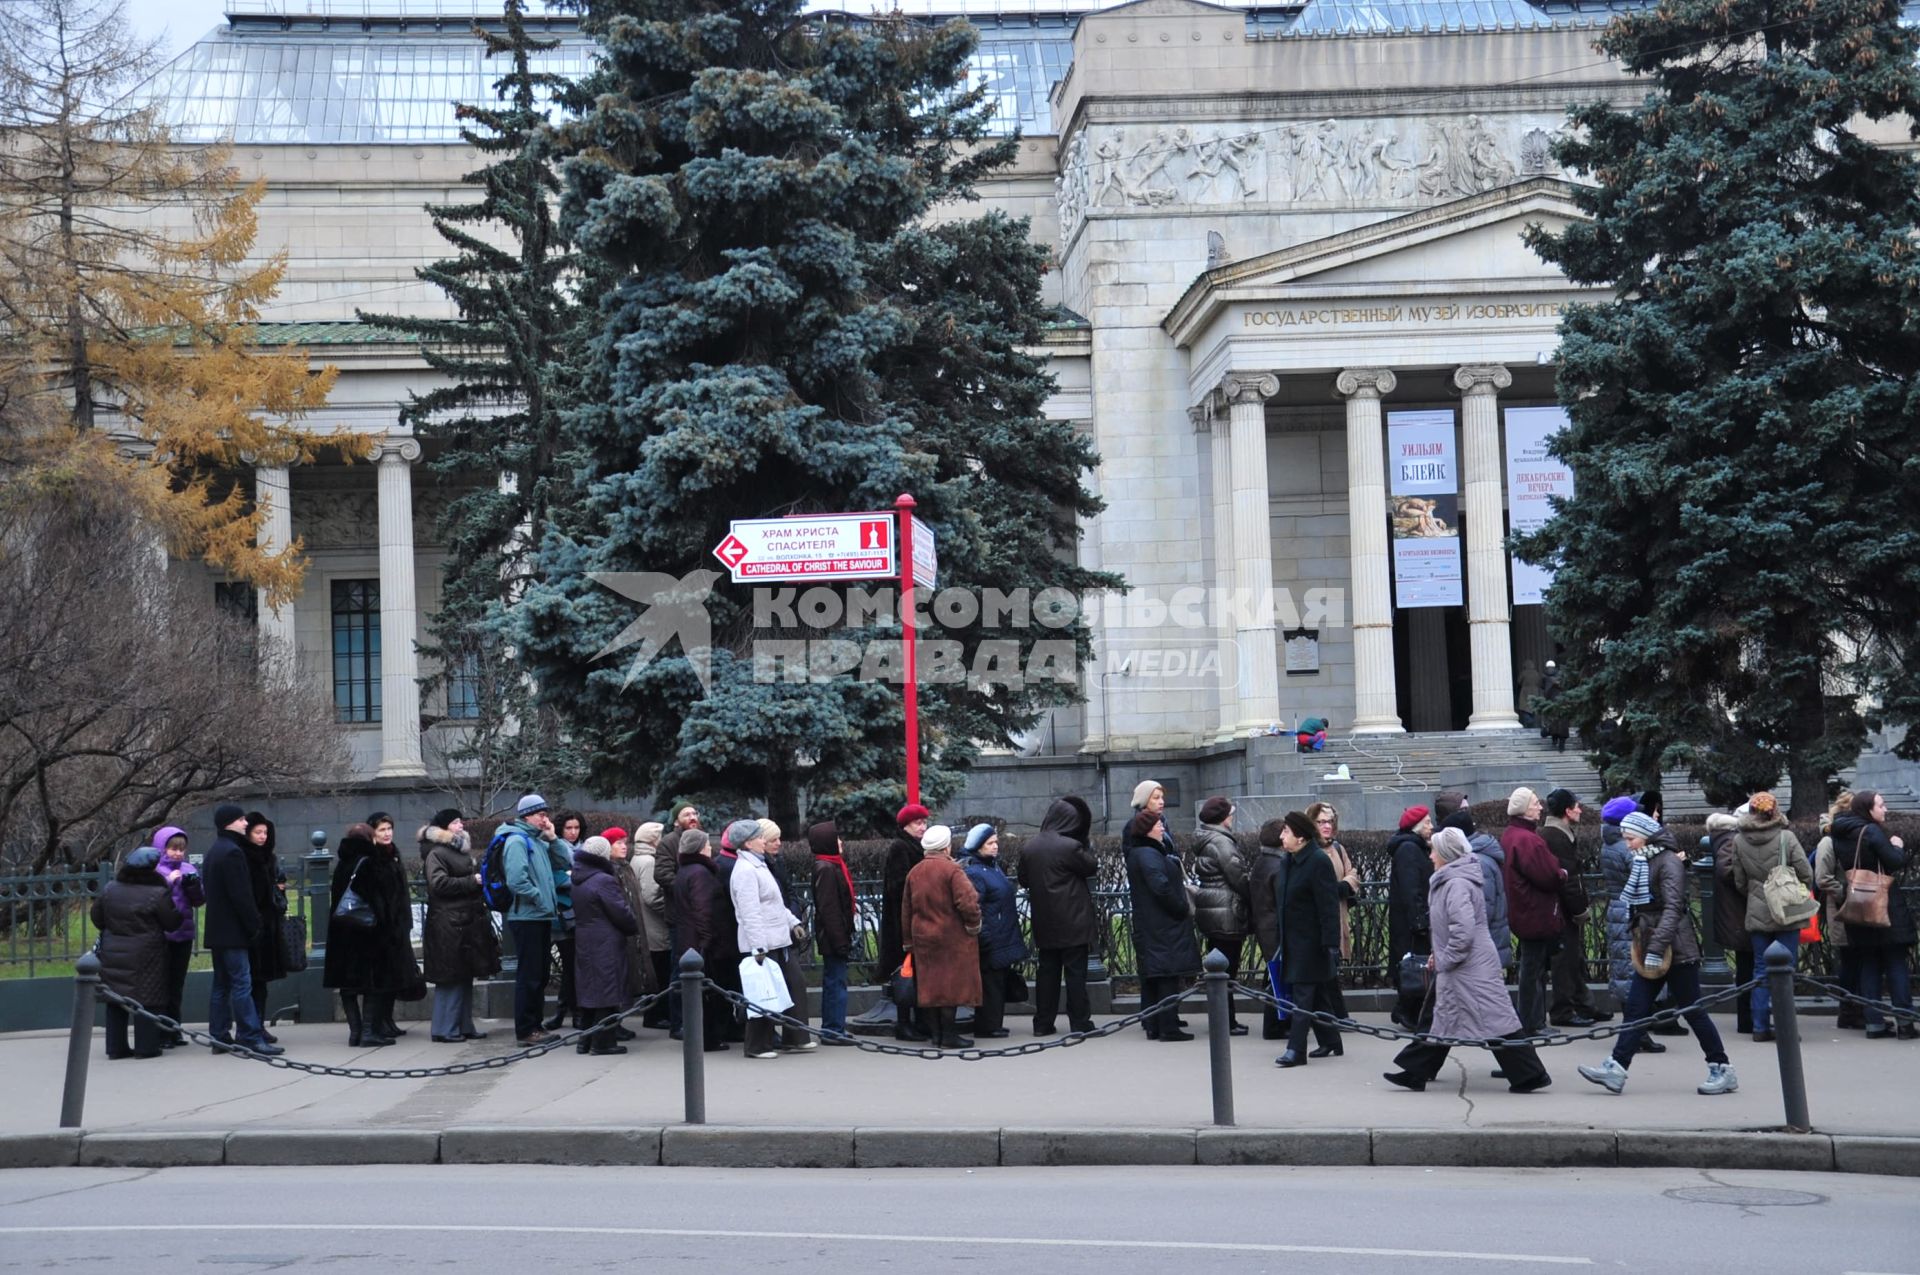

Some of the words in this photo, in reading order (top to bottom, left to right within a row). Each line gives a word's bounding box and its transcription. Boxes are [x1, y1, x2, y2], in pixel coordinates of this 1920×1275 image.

[1243, 306, 1403, 327] ГОСУДАРСТВЕННЫЙ
[1408, 303, 1460, 323] МУЗЕЙ
[1401, 442, 1444, 457] УИЛЬЯМ
[1401, 462, 1446, 481] БЛЕЙК
[1516, 471, 1566, 484] ДЕКАБРЬСКИЕ
[1527, 482, 1554, 493] ВЕЧЕРА
[762, 528, 792, 539] ХРАМ
[796, 526, 839, 537] ХРИСТА
[767, 539, 836, 551] СПАСИТЕЛЯ
[746, 563, 791, 574] CATHEDRAL
[791, 562, 803, 573] OF
[803, 561, 832, 572] CHRIST
[832, 560, 849, 571] THE
[849, 558, 883, 570] SAVIOUR
